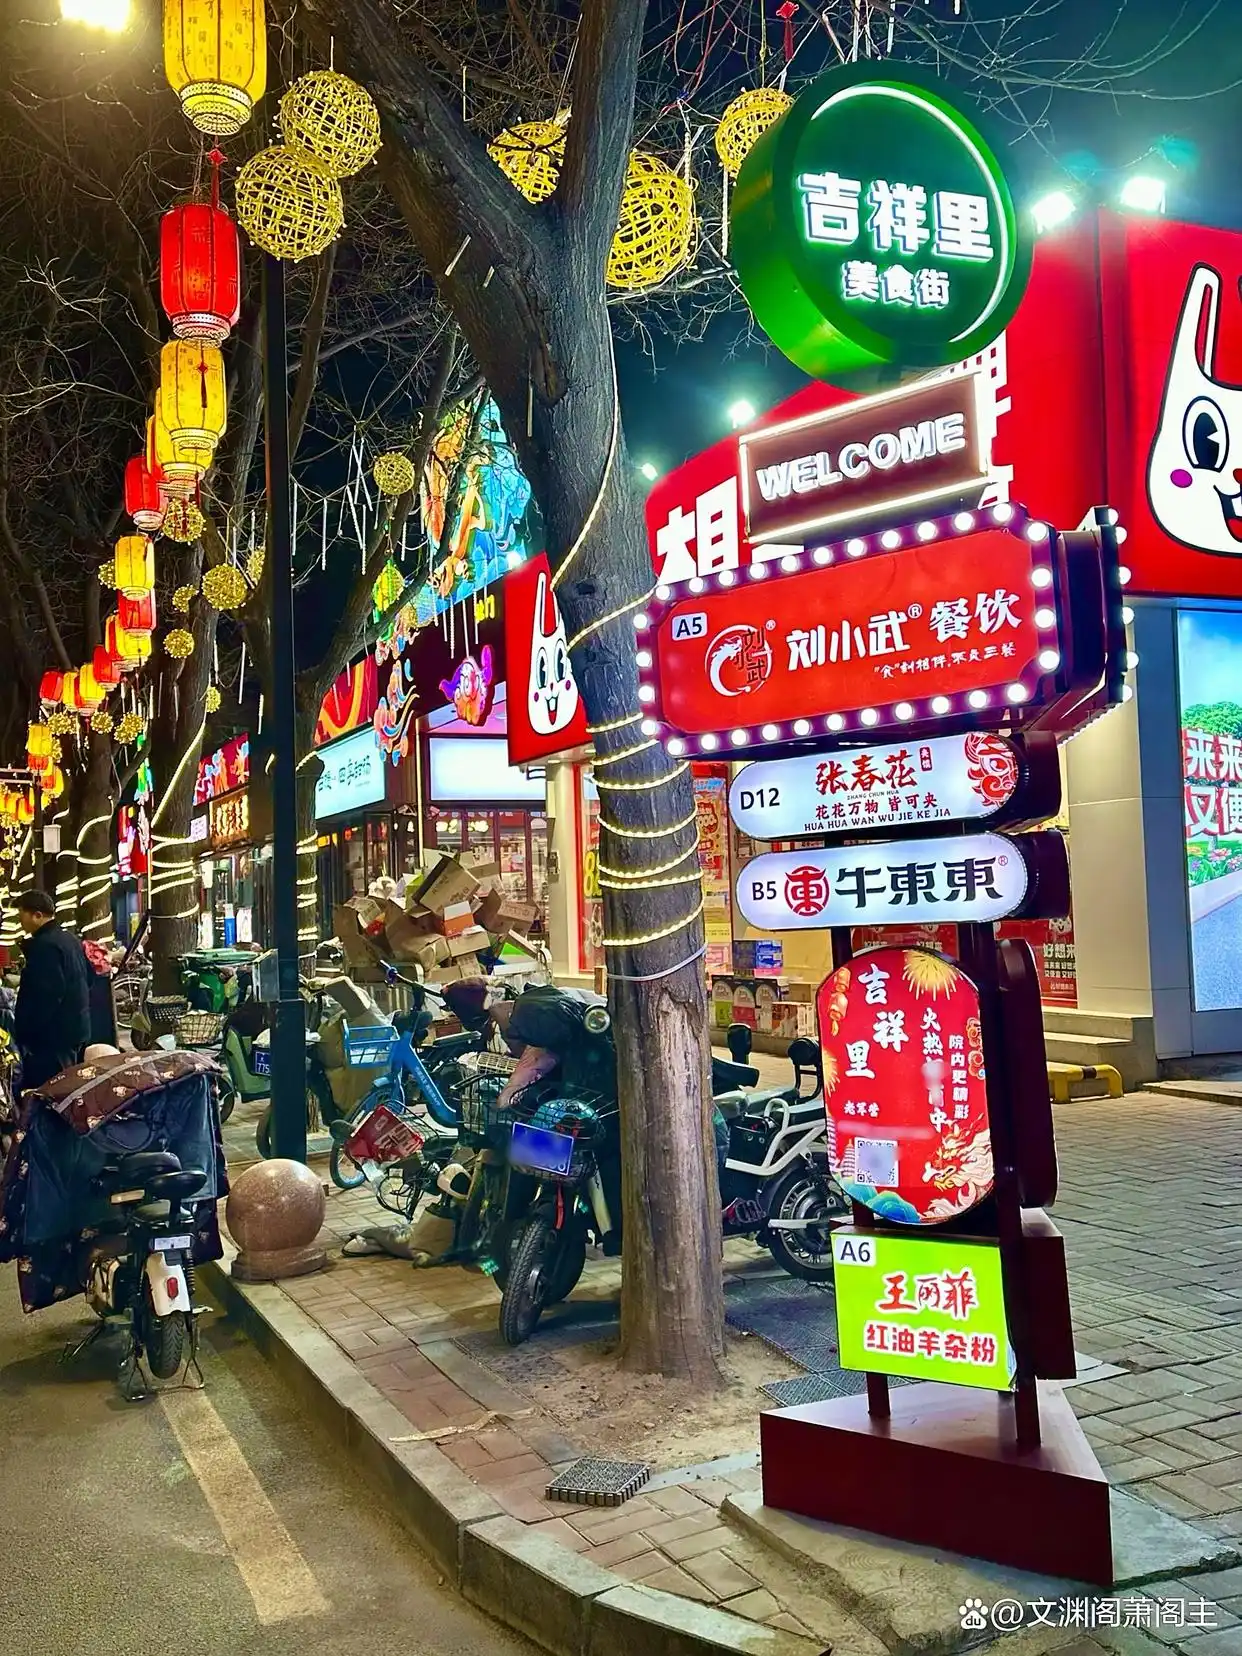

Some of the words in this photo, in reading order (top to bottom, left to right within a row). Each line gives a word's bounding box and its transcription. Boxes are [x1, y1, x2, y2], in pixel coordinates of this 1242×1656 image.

[798, 172, 994, 262] 吉祥里
[842, 260, 950, 309] 美食街
[755, 413, 966, 501] WELCOME
[675, 615, 703, 638] A5
[930, 589, 1022, 643] 餐饮
[816, 750, 918, 796] 张春花
[740, 787, 780, 810] D12
[804, 822, 824, 832] HUA
[827, 820, 848, 829] HUA
[851, 816, 875, 826] WAN
[878, 813, 895, 823] WU
[898, 811, 913, 821] JIE
[917, 810, 931, 819] KE
[935, 808, 951, 818] JIA
[815, 799, 879, 820] 花花万物
[752, 881, 777, 900] B5
[835, 856, 1004, 909] 牛東東
[845, 963, 909, 1079] 吉祥里
[948, 1034, 970, 1120] 院内更精彩
[839, 1240, 871, 1262] A6
[878, 1270, 976, 1318] 王丽菲
[866, 1323, 996, 1364] 红油羊杂粉
